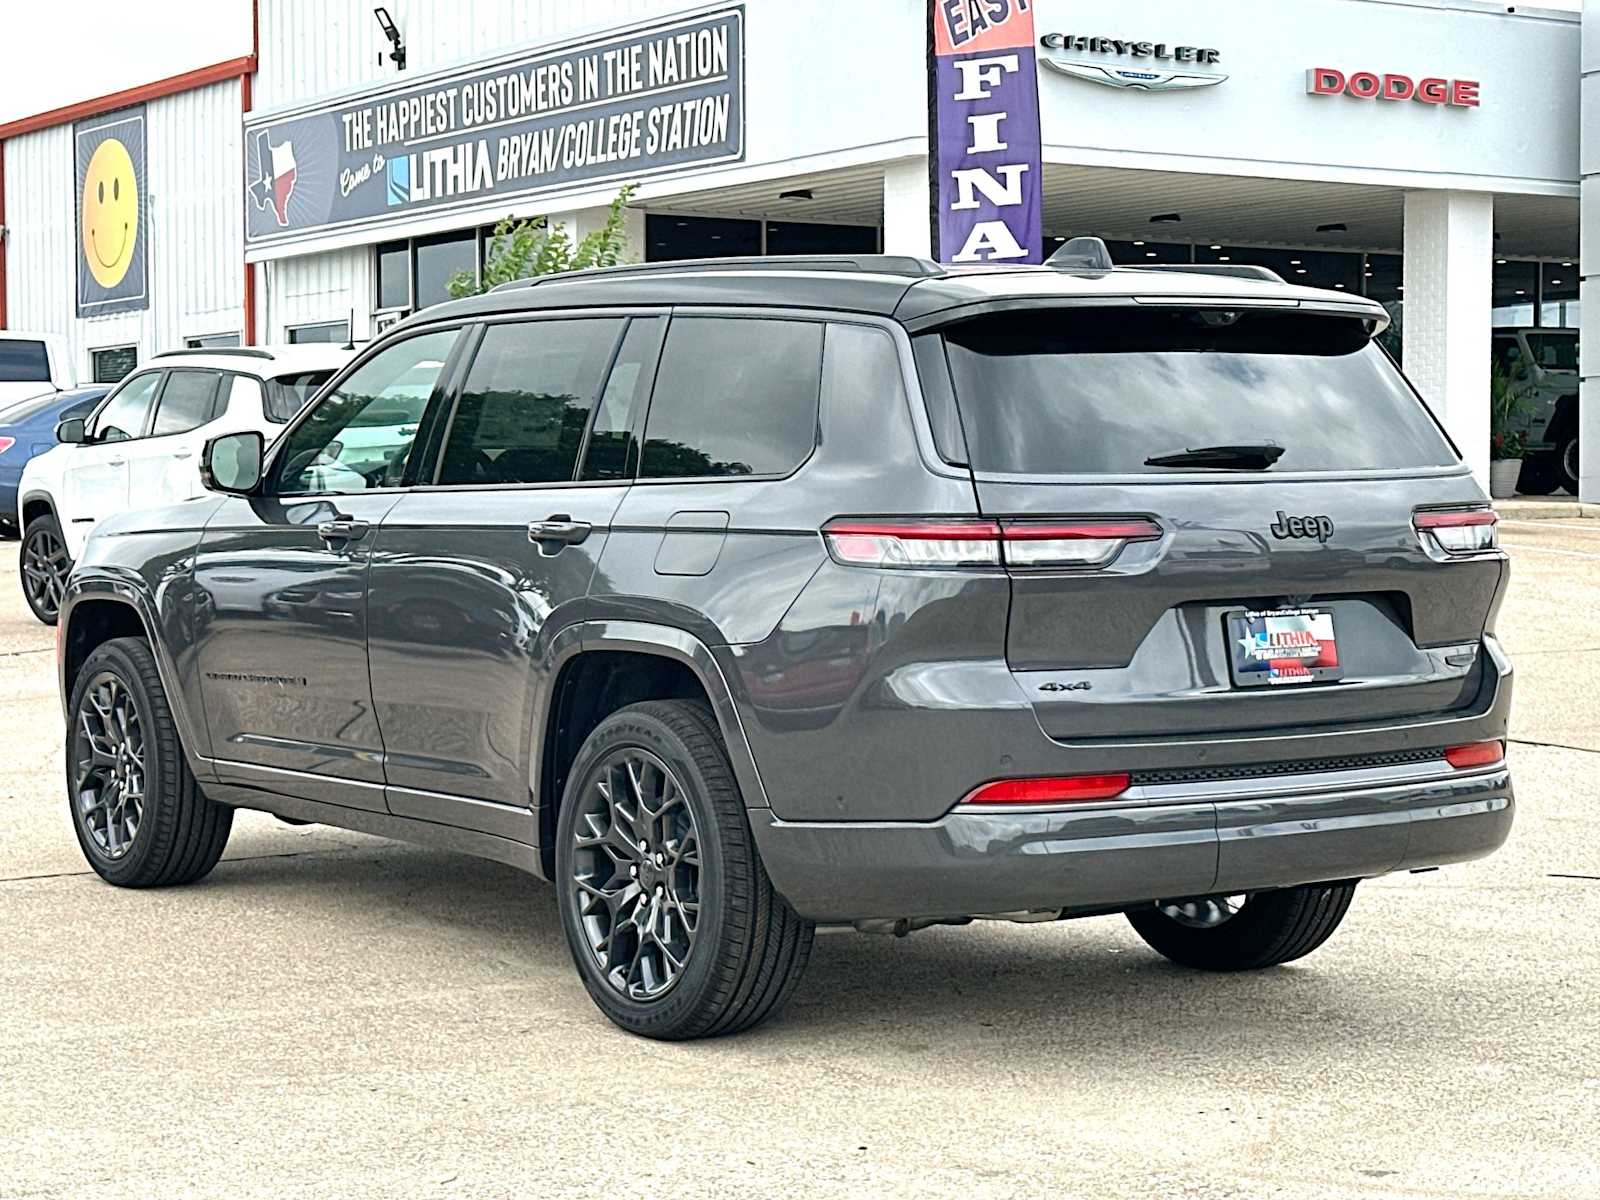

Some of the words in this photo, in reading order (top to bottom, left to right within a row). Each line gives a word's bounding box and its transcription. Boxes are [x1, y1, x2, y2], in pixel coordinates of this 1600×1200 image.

[943, 0, 1028, 46] EAS
[1040, 32, 1221, 63] CHRYSLER
[342, 109, 373, 152] THE
[377, 88, 458, 145] HAPPIEST
[462, 61, 574, 127] CUSTOMERS
[578, 55, 599, 101] IN
[603, 44, 644, 96] THE
[648, 25, 728, 87] NATION
[1305, 68, 1480, 107] DODGE
[409, 140, 494, 202] LITHIA
[497, 110, 644, 181] BRYAN/COLLEGE
[646, 93, 730, 155] STATION
[340, 167, 371, 197] Come
[373, 153, 385, 173] to
[1270, 510, 1334, 543] Jeep
[1269, 631, 1318, 648] LITHIA
[1038, 680, 1092, 692] 4x4
